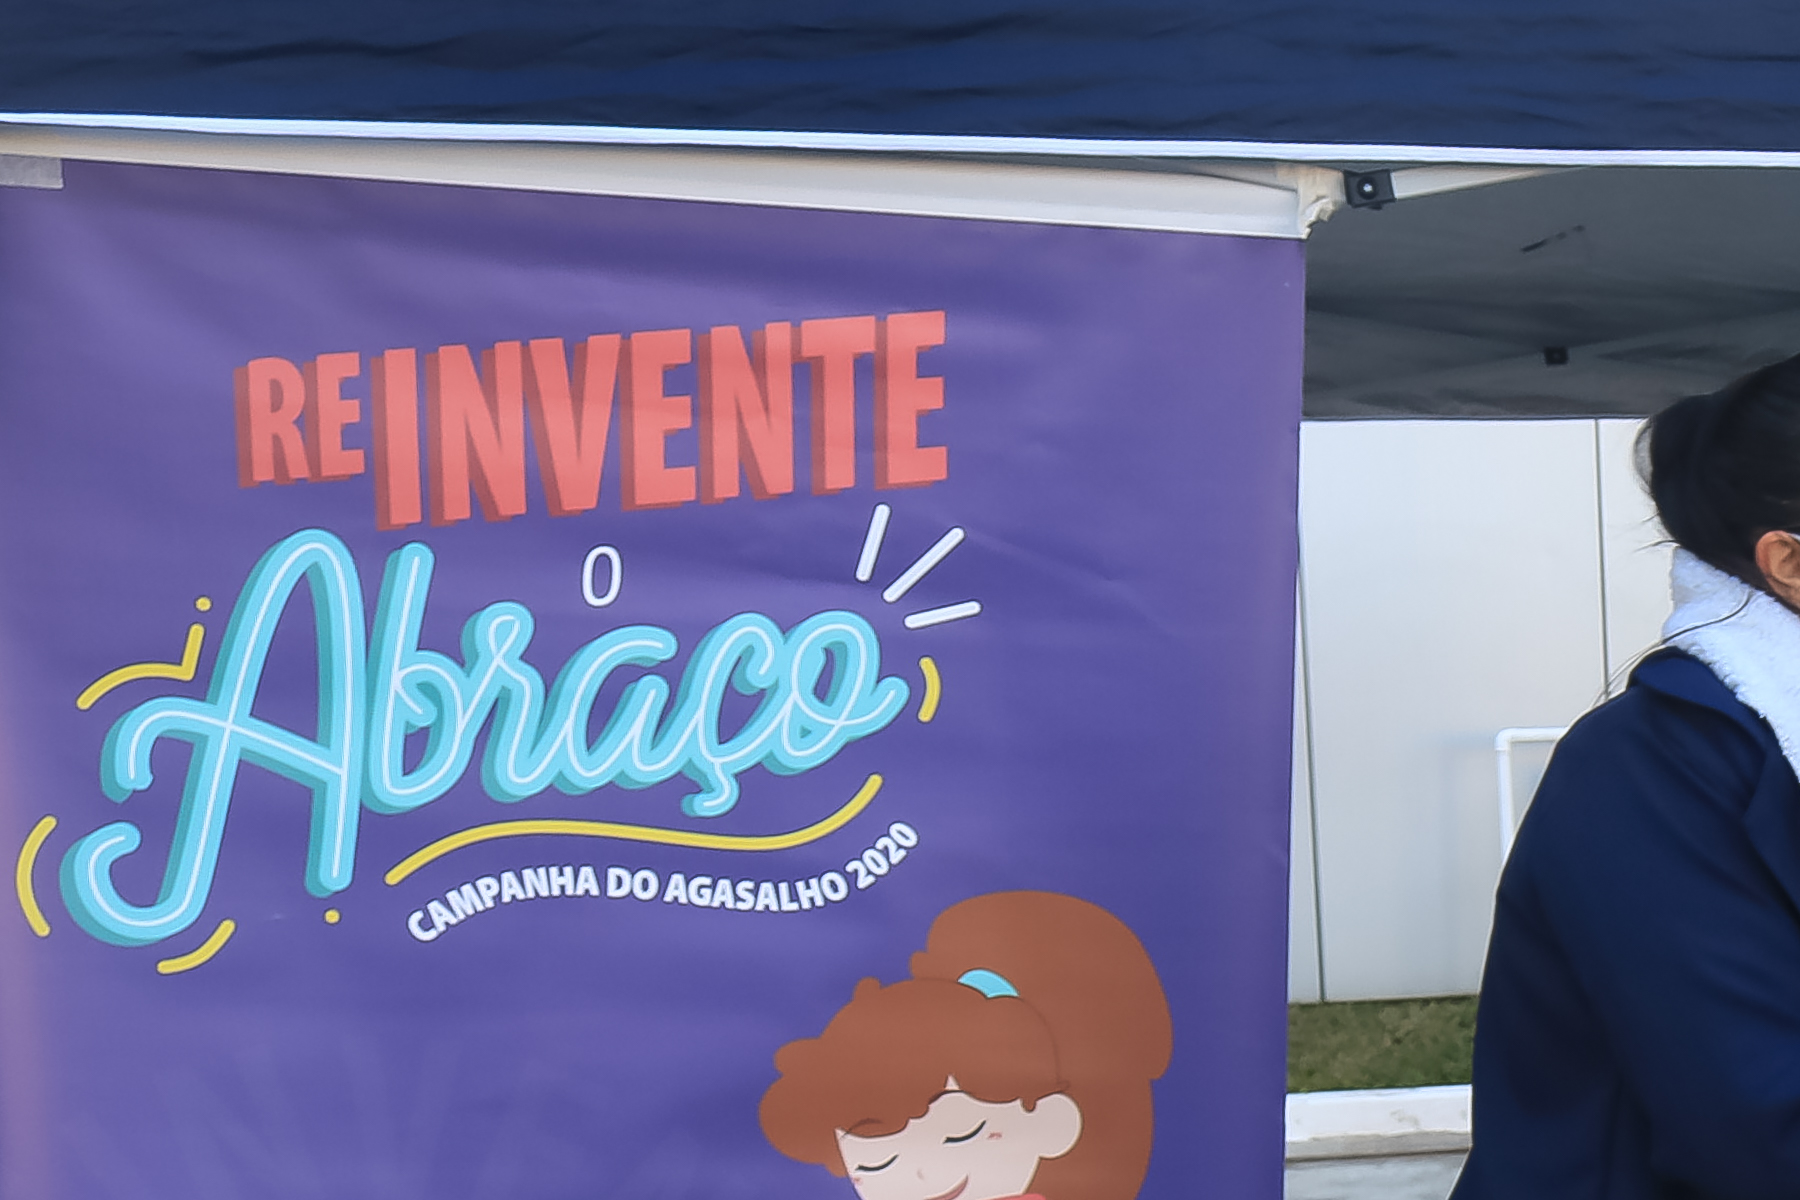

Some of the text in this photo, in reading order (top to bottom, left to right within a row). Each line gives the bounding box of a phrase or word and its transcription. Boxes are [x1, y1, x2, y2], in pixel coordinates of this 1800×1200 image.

[60, 527, 909, 946] Abraço
[407, 822, 918, 942] CAMPANHA DO AGASALHO 2020
